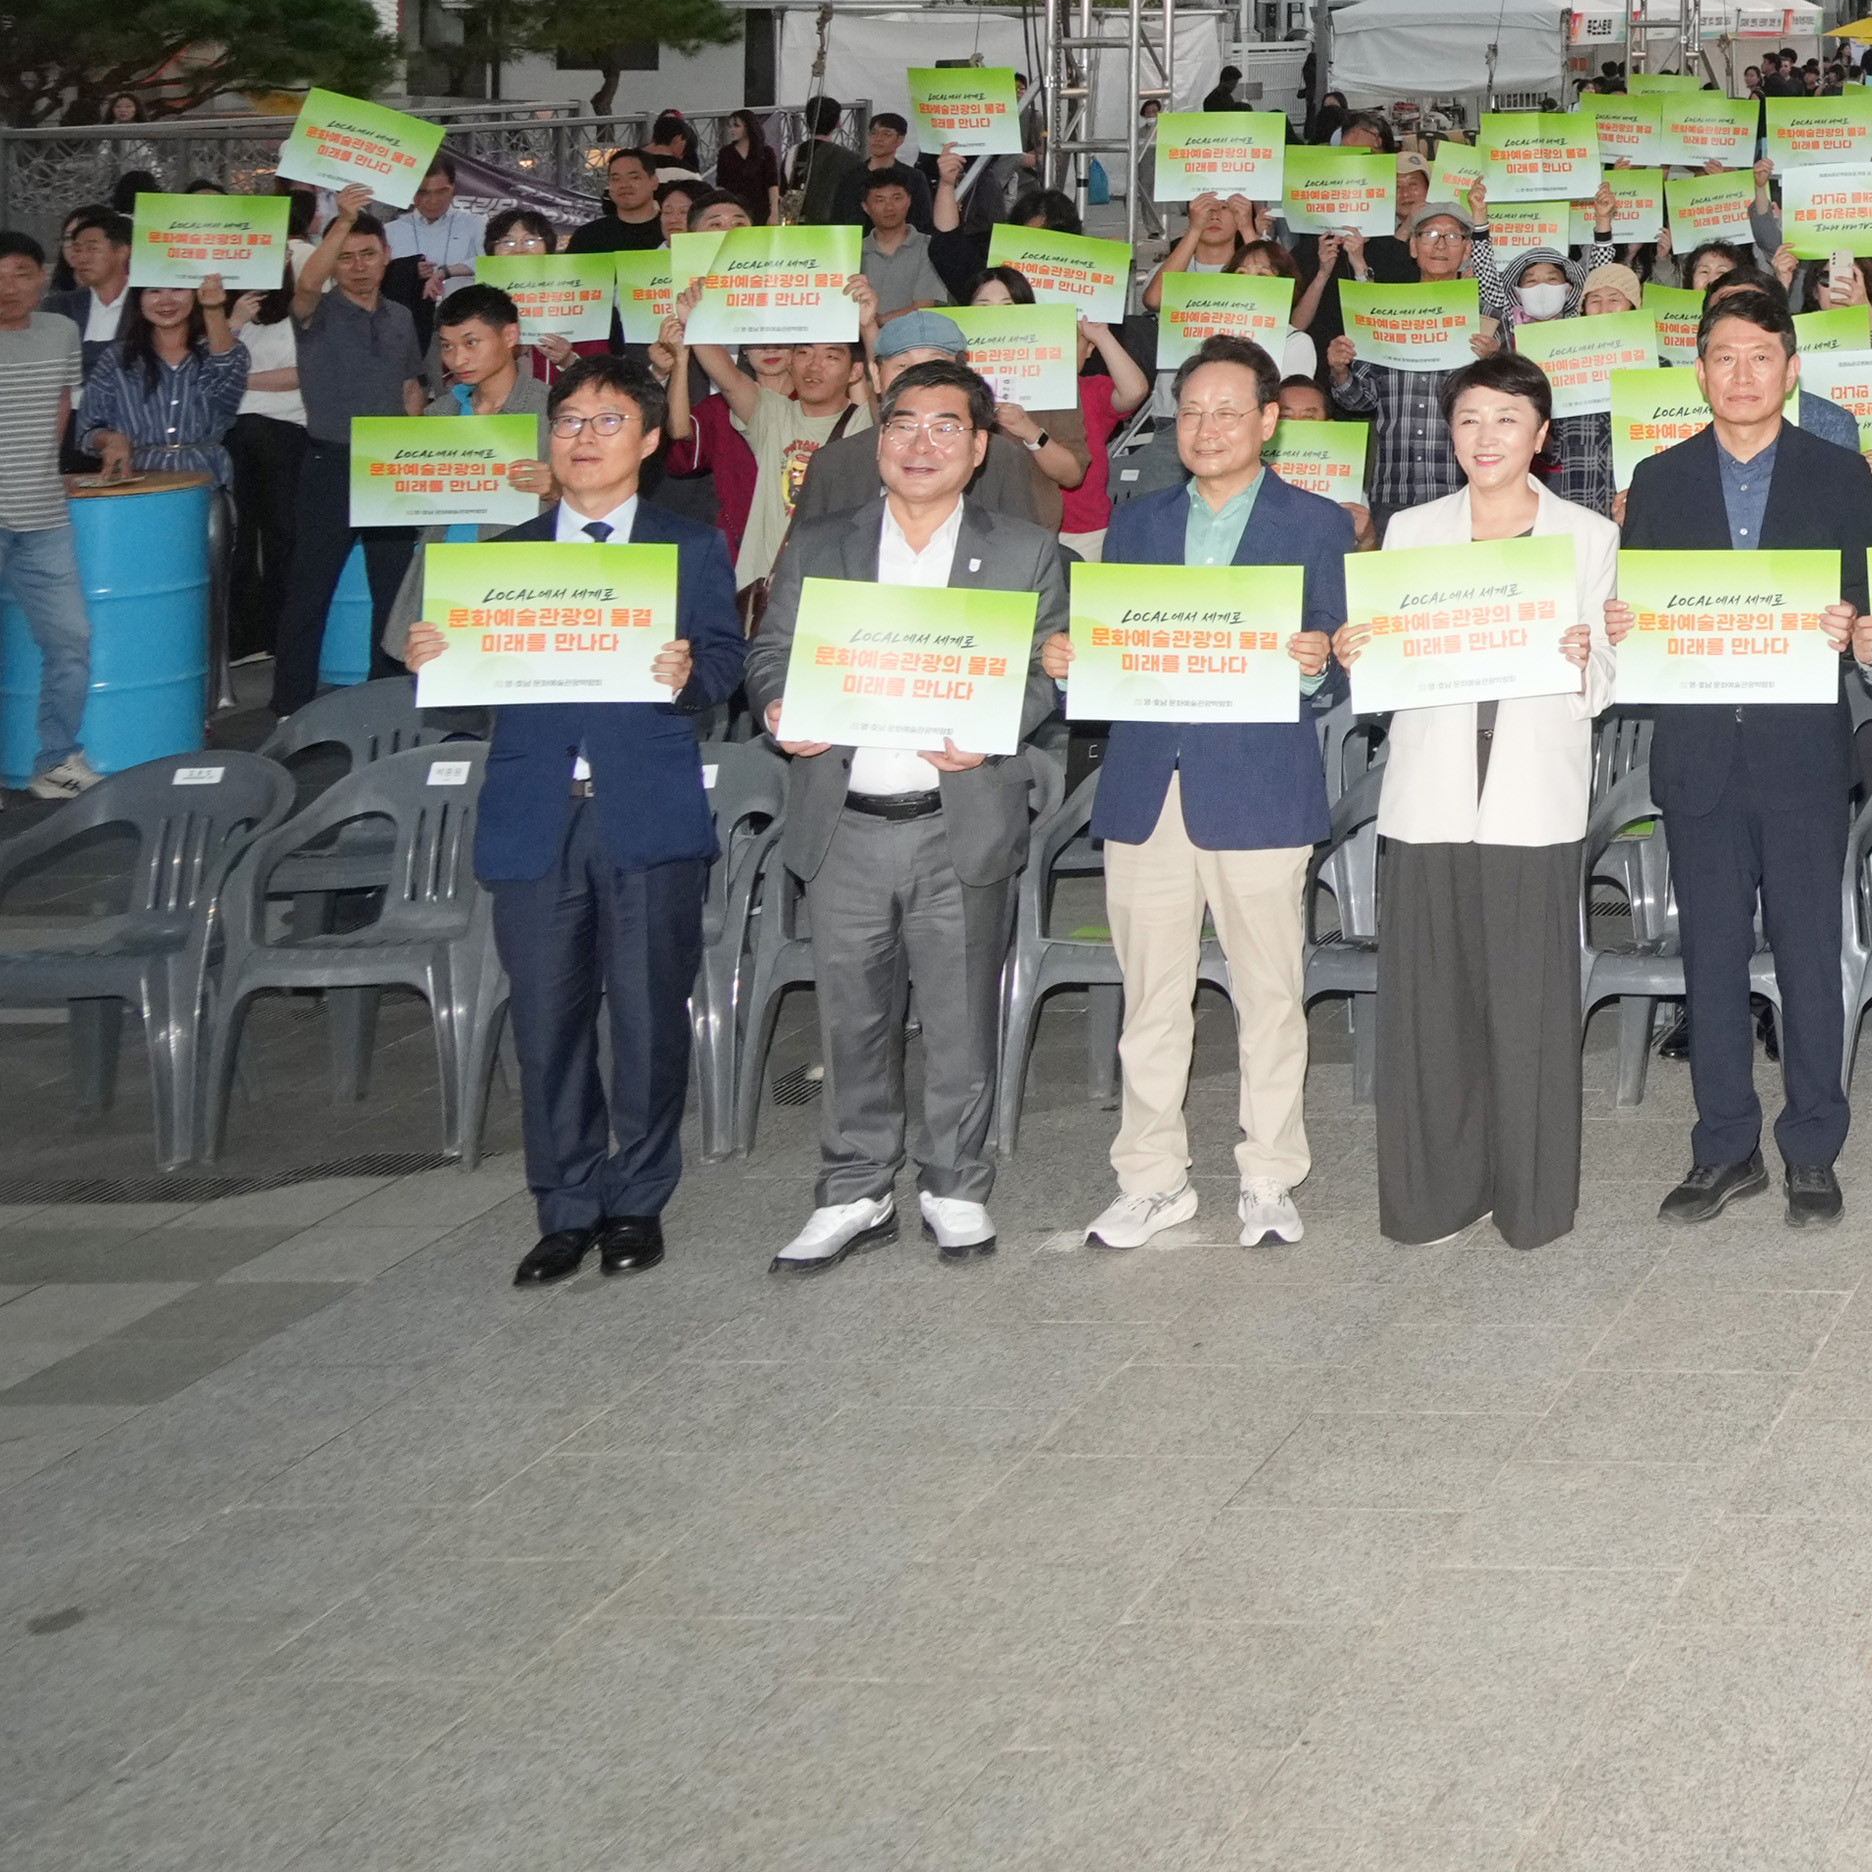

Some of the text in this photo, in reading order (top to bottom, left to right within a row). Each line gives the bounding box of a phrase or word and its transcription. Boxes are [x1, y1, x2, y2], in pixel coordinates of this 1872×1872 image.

[146, 231, 272, 245] 문화예술관광의 물결
[166, 247, 252, 260] 미래를 만나다
[482, 587, 620, 603] LOCAL에서 세계로
[1666, 593, 1789, 609] LOCAL에서 세계로
[447, 606, 652, 628] 문화예술관광의 물결
[1120, 608, 1248, 625] LOCAL에서 세계로
[1637, 611, 1819, 632] 문화예술관광의 물결
[480, 632, 620, 654] 미래를 만나다
[932, 632, 981, 650] 세계로
[1090, 627, 1278, 650] 문화예술관광의 물결
[1666, 636, 1789, 656] 미래를 만나다
[812, 645, 1008, 677] 문화예술관광의 물결
[1120, 653, 1248, 674] 미래를 만나다
[840, 674, 975, 701] 미래를 만나다
